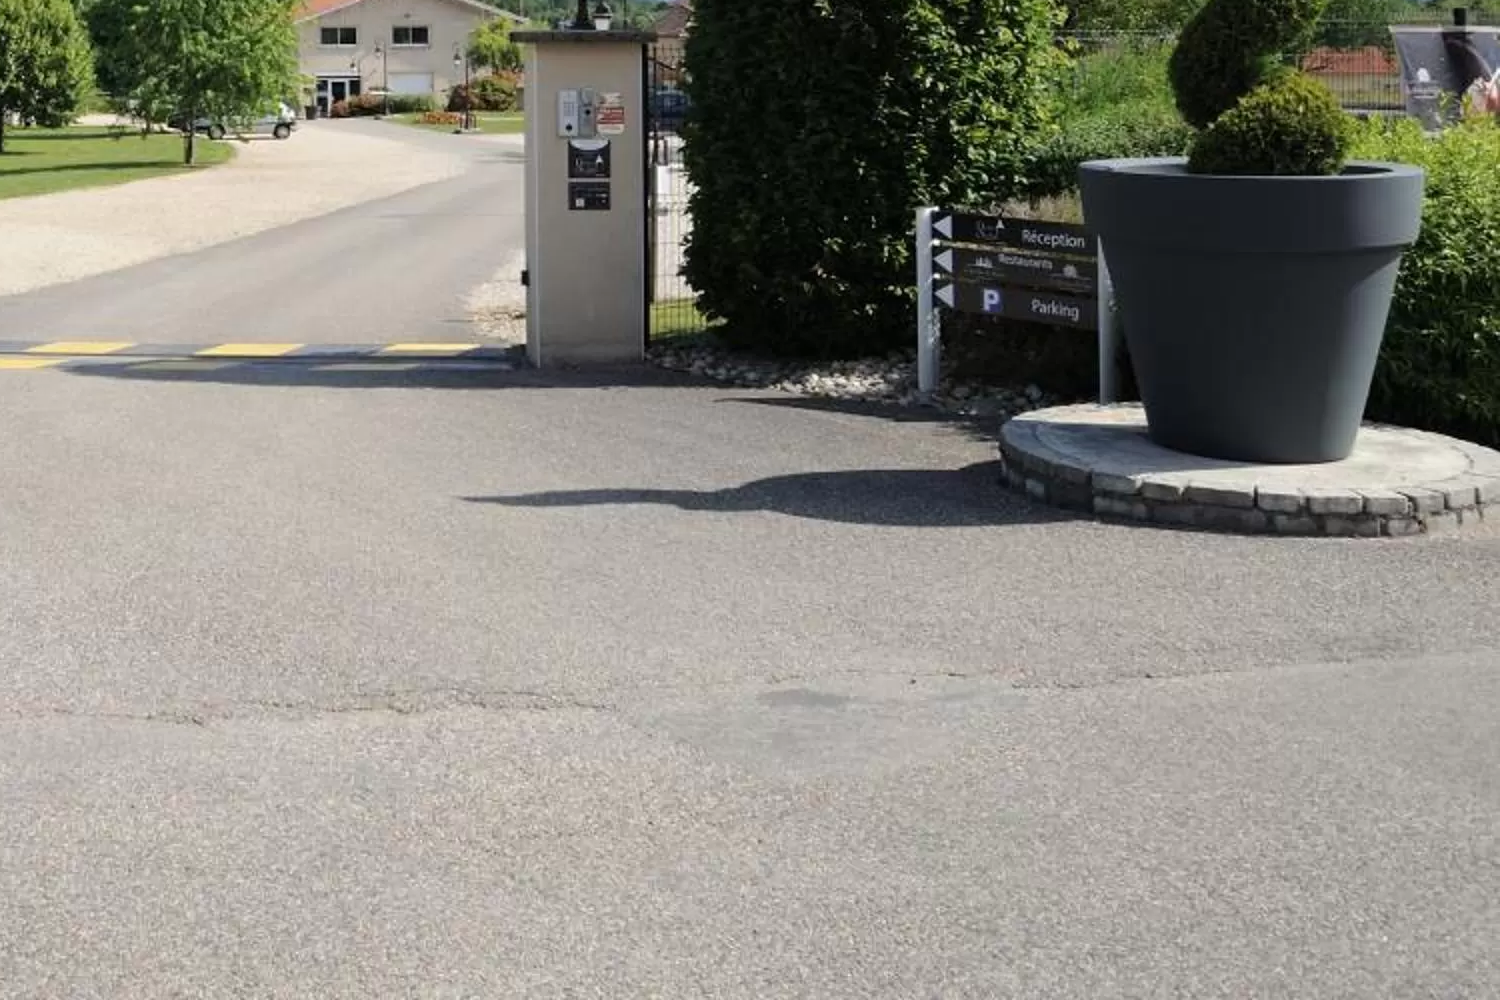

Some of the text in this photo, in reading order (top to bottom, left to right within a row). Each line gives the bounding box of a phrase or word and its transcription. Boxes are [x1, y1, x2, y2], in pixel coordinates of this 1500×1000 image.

[1021, 228, 1086, 249] Réception
[983, 289, 1000, 312] P
[1031, 299, 1081, 322] Parking
